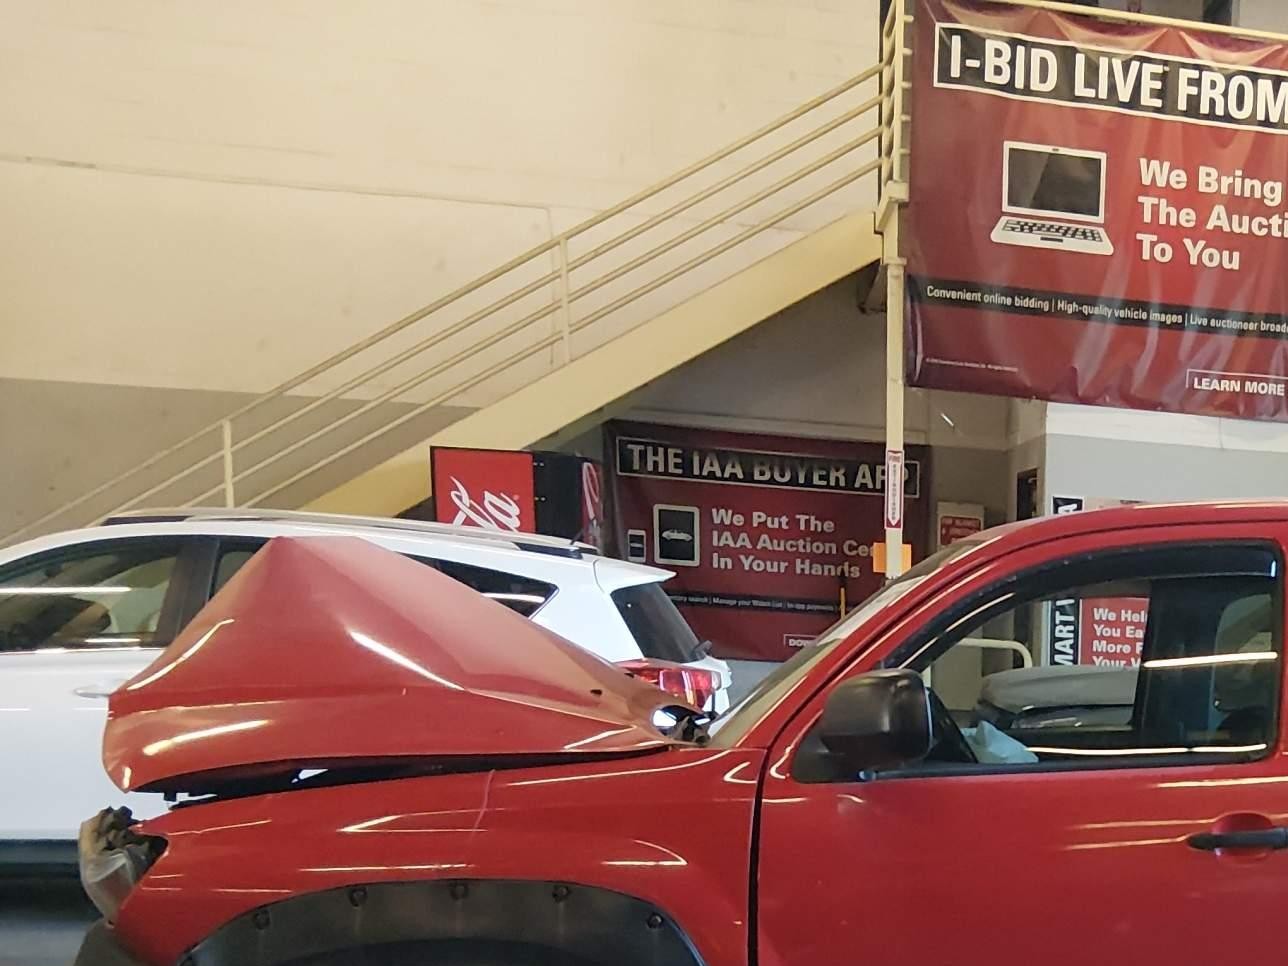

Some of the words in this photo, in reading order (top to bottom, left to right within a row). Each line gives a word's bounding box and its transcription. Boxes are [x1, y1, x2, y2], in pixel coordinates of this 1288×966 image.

[950, 35, 1057, 92] I-BID
[1074, 53, 1164, 107] LIVE
[1139, 157, 1187, 190] We
[1198, 165, 1283, 207] Bring
[1137, 196, 1196, 228] The
[1136, 233, 1173, 263] To
[1183, 238, 1240, 270] You
[926, 285, 982, 303] Convenient
[983, 292, 1012, 306] online
[1014, 296, 1050, 312] bidding
[1056, 299, 1112, 319] High-quality
[1113, 306, 1148, 320] vehicle
[1149, 309, 1183, 325] images
[1189, 315, 1208, 327] Live
[1210, 318, 1258, 332] auctioneer
[1193, 377, 1242, 393] LEARN
[1244, 381, 1286, 397] MORE
[627, 444, 683, 475] THE
[692, 450, 744, 480] IAA
[753, 456, 847, 489] BUYER
[711, 508, 745, 527] We
[752, 511, 790, 530] Put
[795, 514, 835, 533] The
[712, 530, 752, 549] IAA
[756, 533, 837, 555] Auction
[712, 552, 733, 570] In
[738, 554, 788, 574] Your
[1093, 607, 1117, 621] We
[1093, 623, 1121, 638] You
[1092, 639, 1132, 653] More
